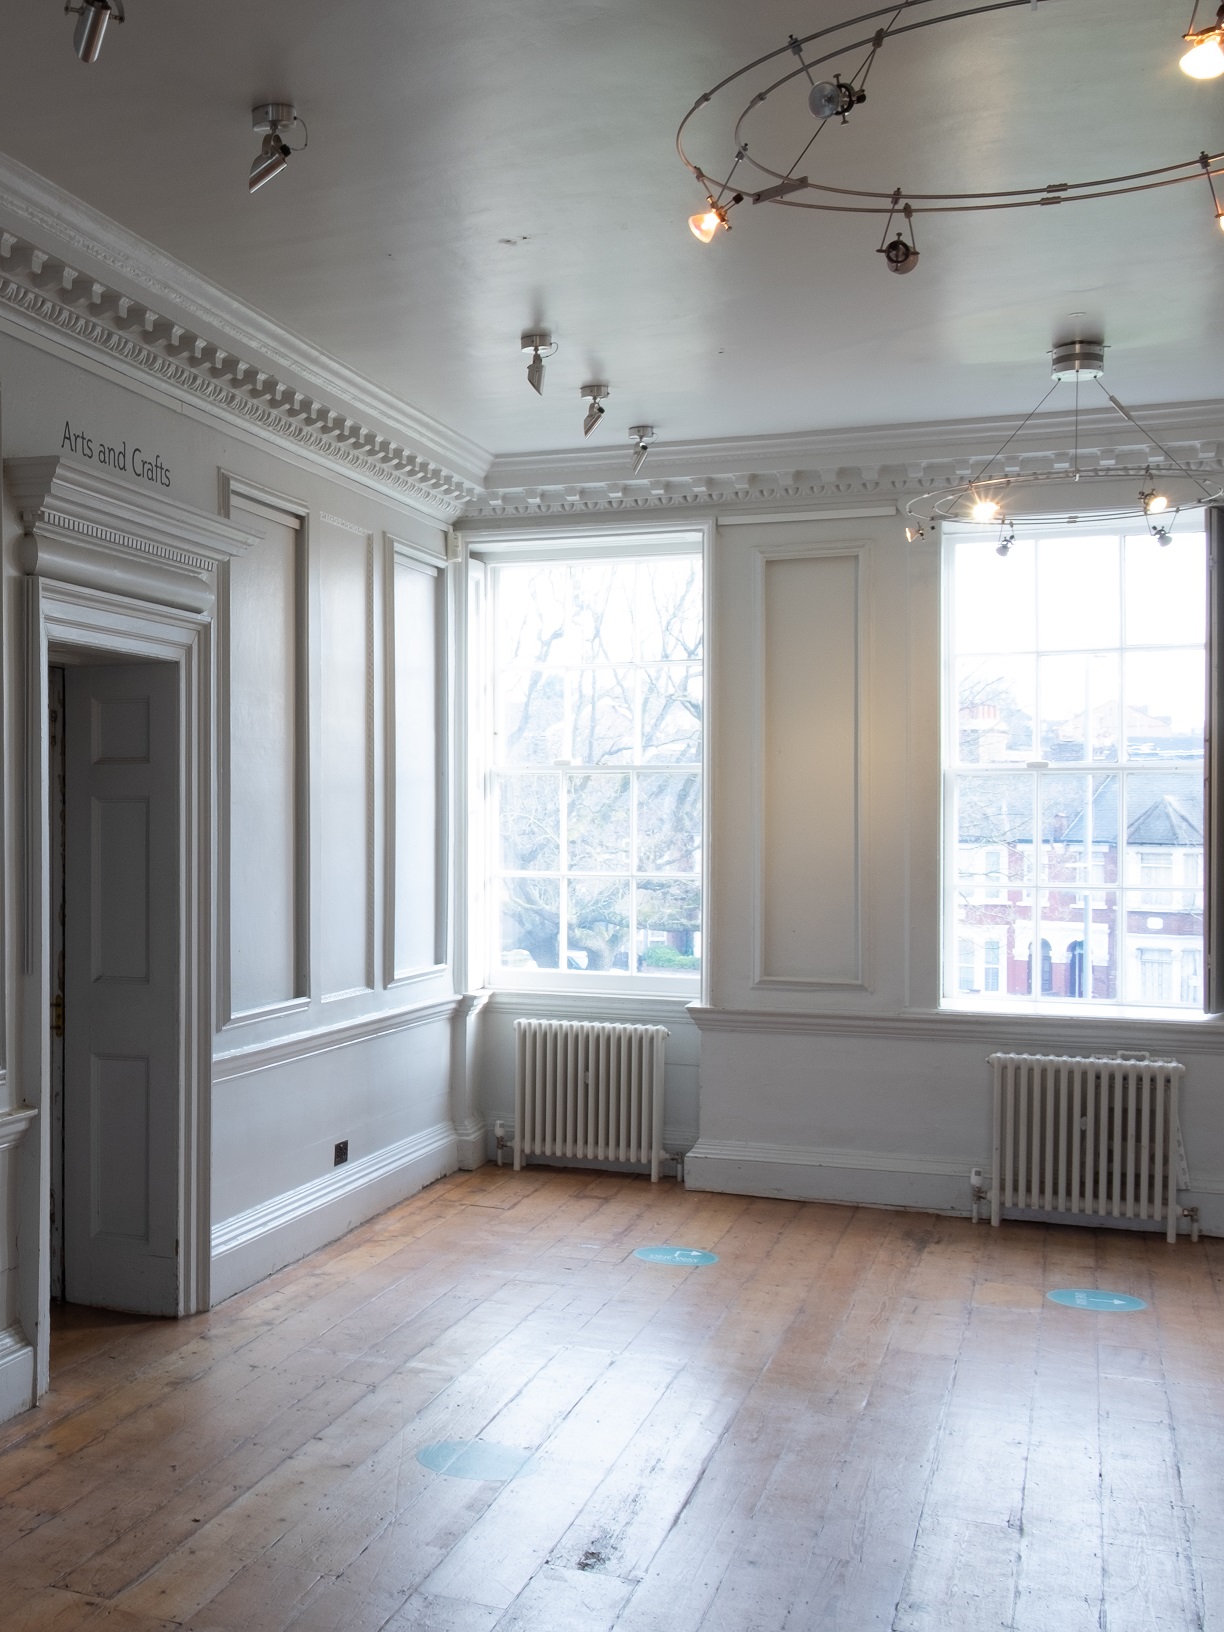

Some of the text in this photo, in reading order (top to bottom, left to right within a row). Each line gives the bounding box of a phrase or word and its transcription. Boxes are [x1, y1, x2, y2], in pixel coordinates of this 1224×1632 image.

[60, 420, 171, 488] Arts and Crafts
